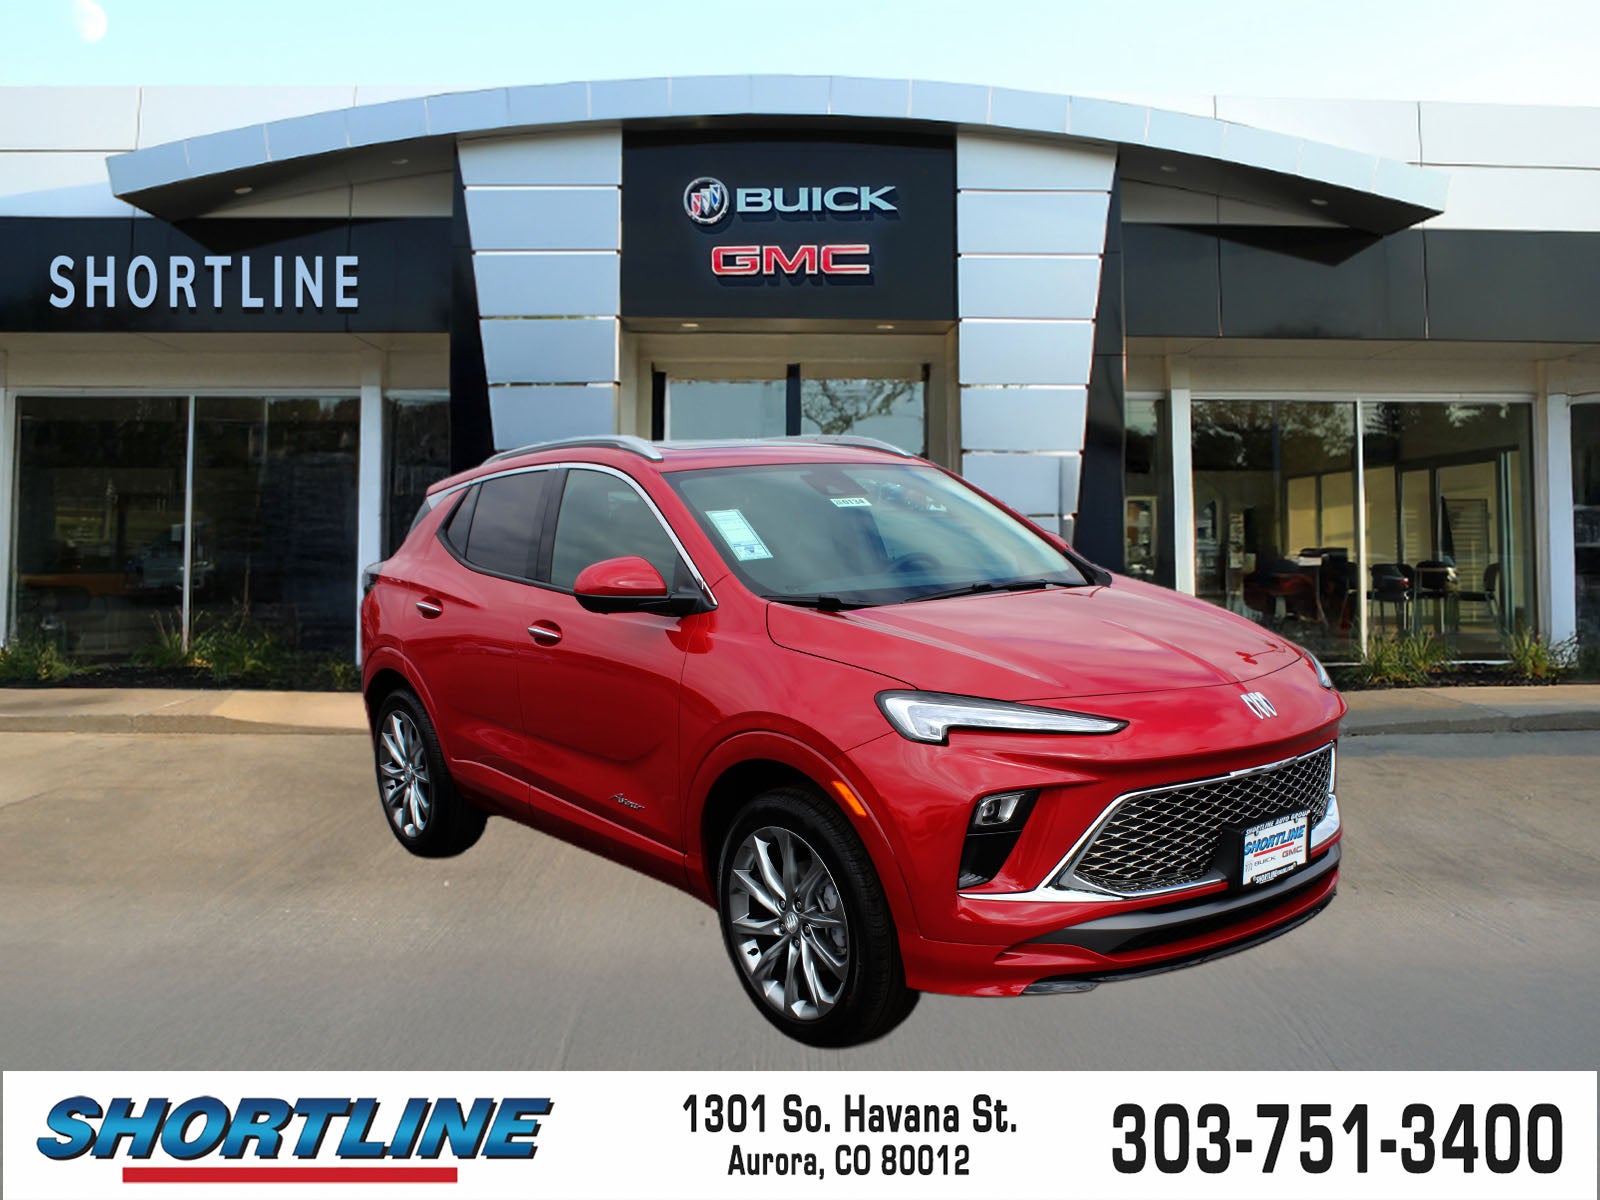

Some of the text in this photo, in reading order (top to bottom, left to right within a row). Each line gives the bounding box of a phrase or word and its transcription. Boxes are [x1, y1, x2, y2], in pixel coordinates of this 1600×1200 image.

[736, 185, 898, 213] BUICK
[711, 244, 870, 276] GMC
[49, 255, 359, 309] SHORTLINE
[1244, 825, 1306, 856] SHORTLINE
[1254, 845, 1303, 867] BUICK GMC
